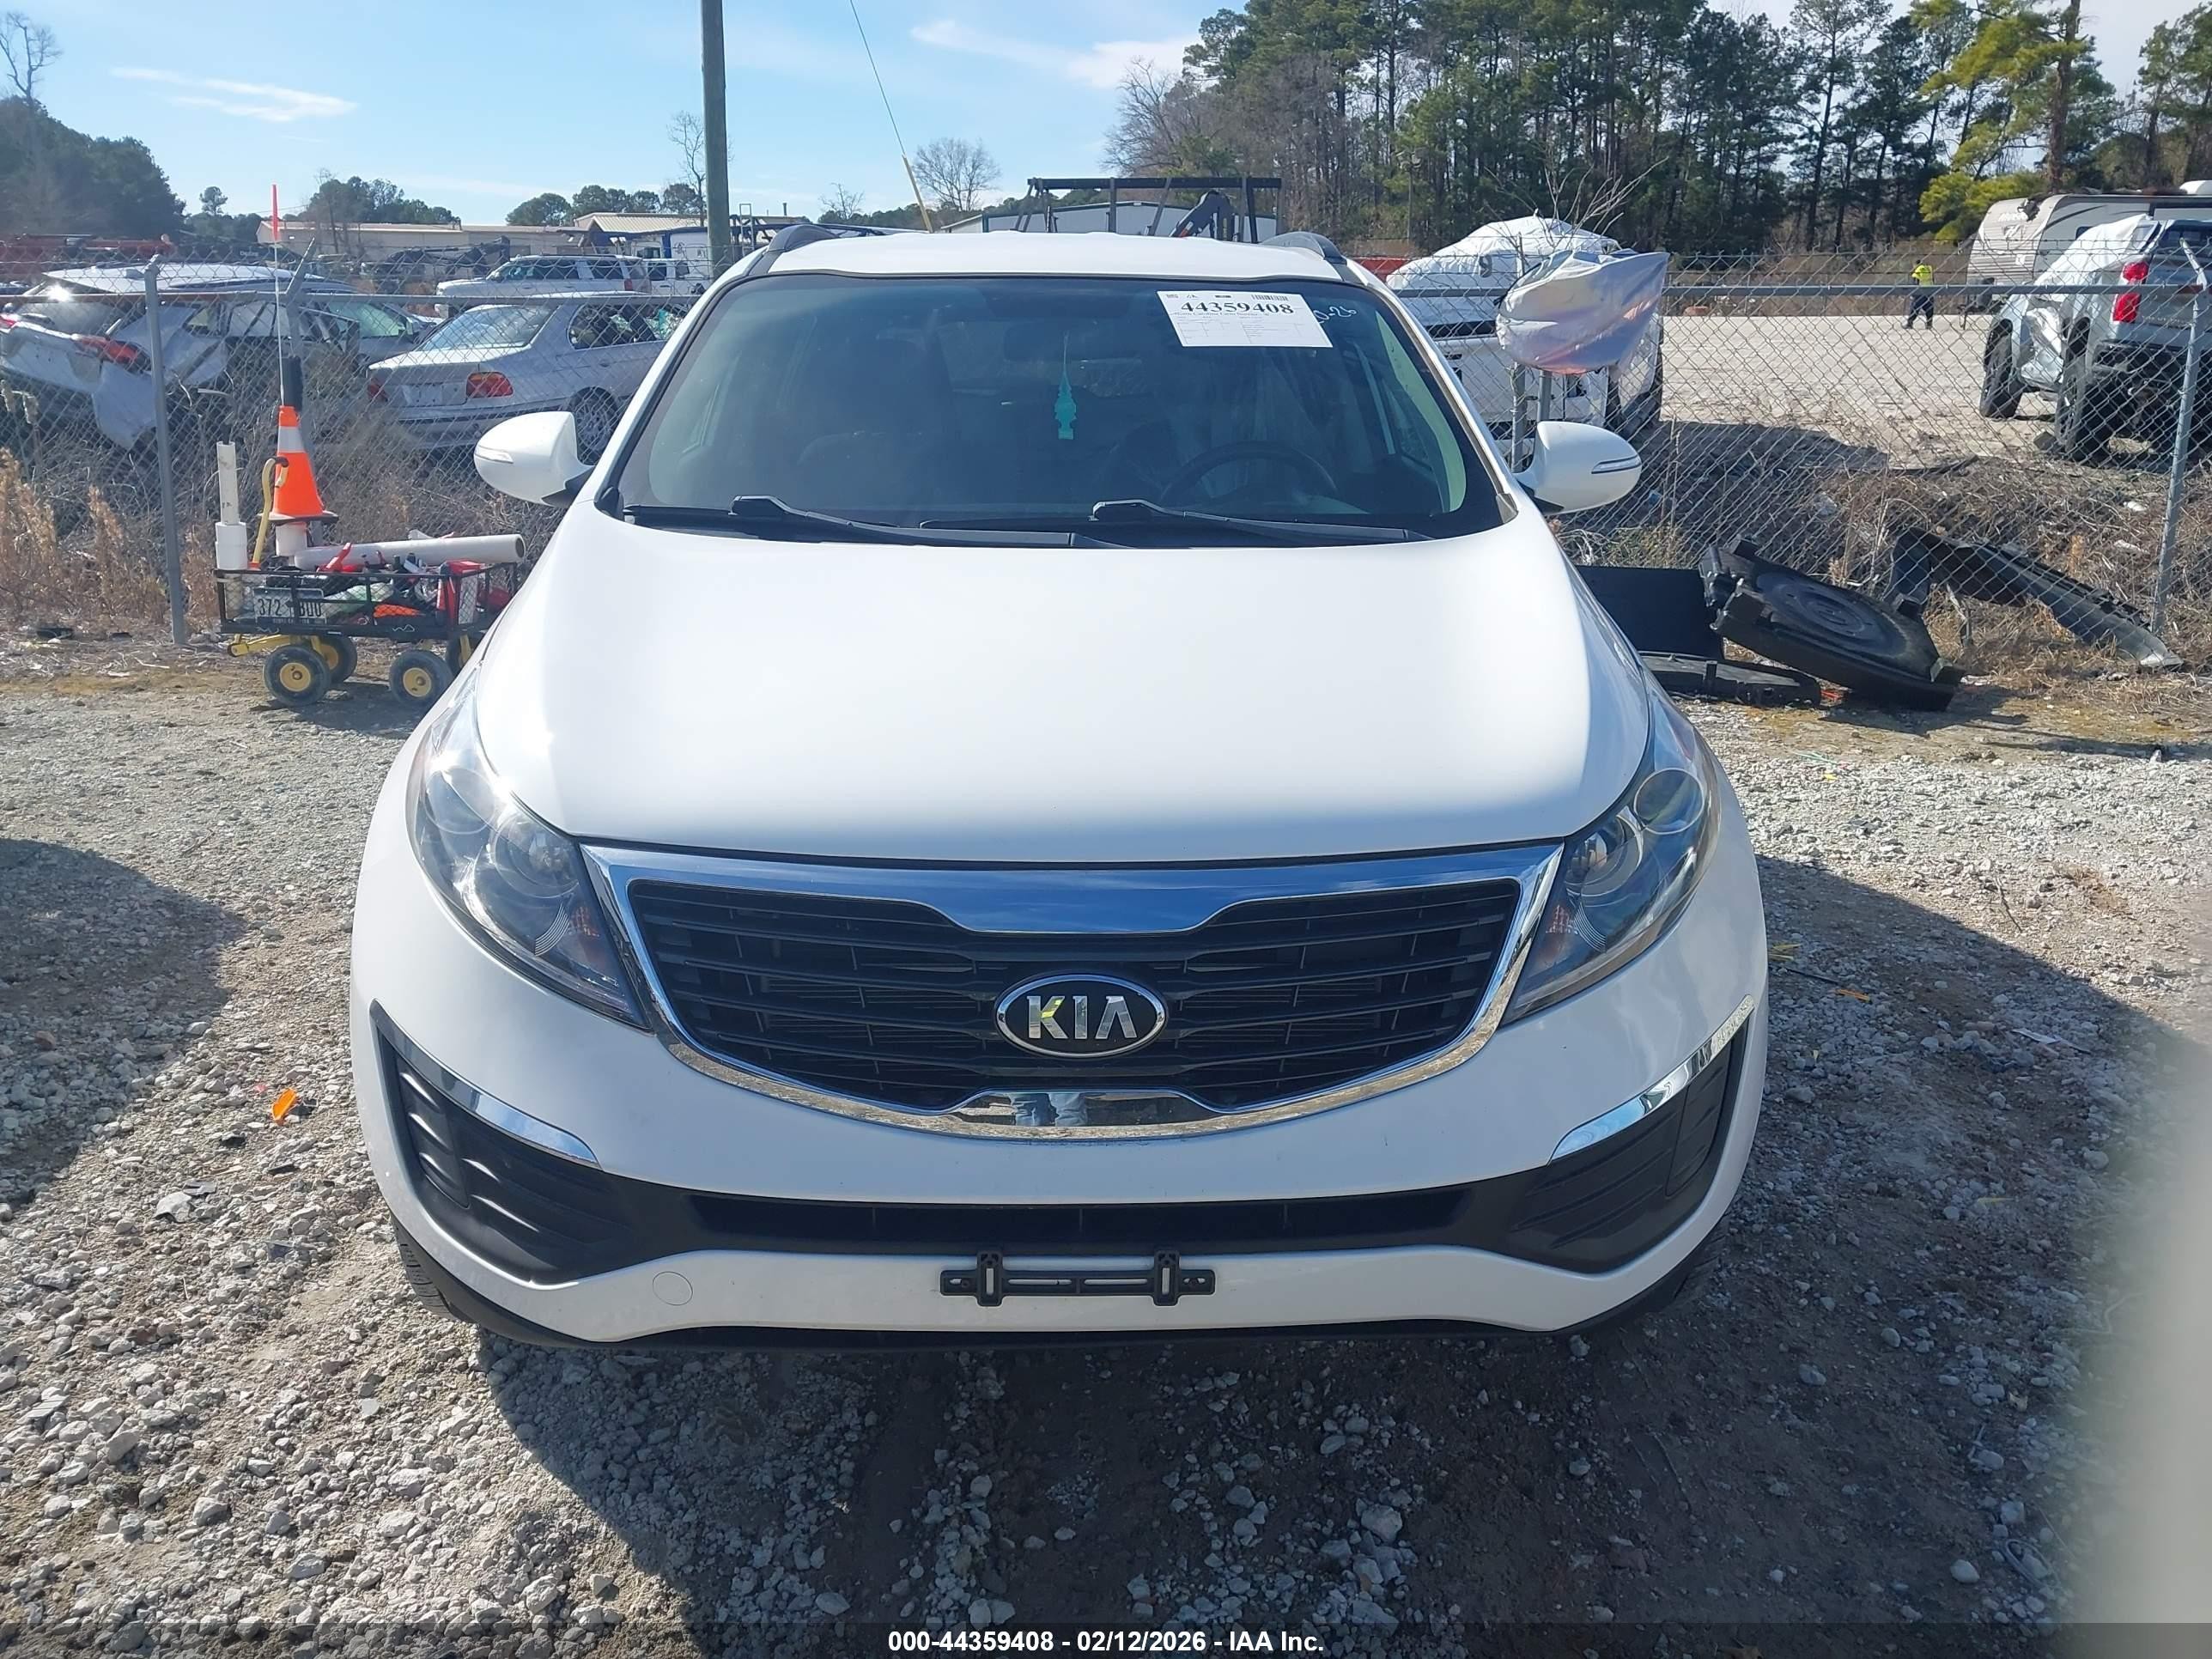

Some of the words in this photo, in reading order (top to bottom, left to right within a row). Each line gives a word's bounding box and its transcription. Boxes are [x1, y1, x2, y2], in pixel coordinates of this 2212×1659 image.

[1182, 302, 1293, 314] 44359408
[258, 598, 282, 617] 372
[1027, 995, 1138, 1040] KIA
